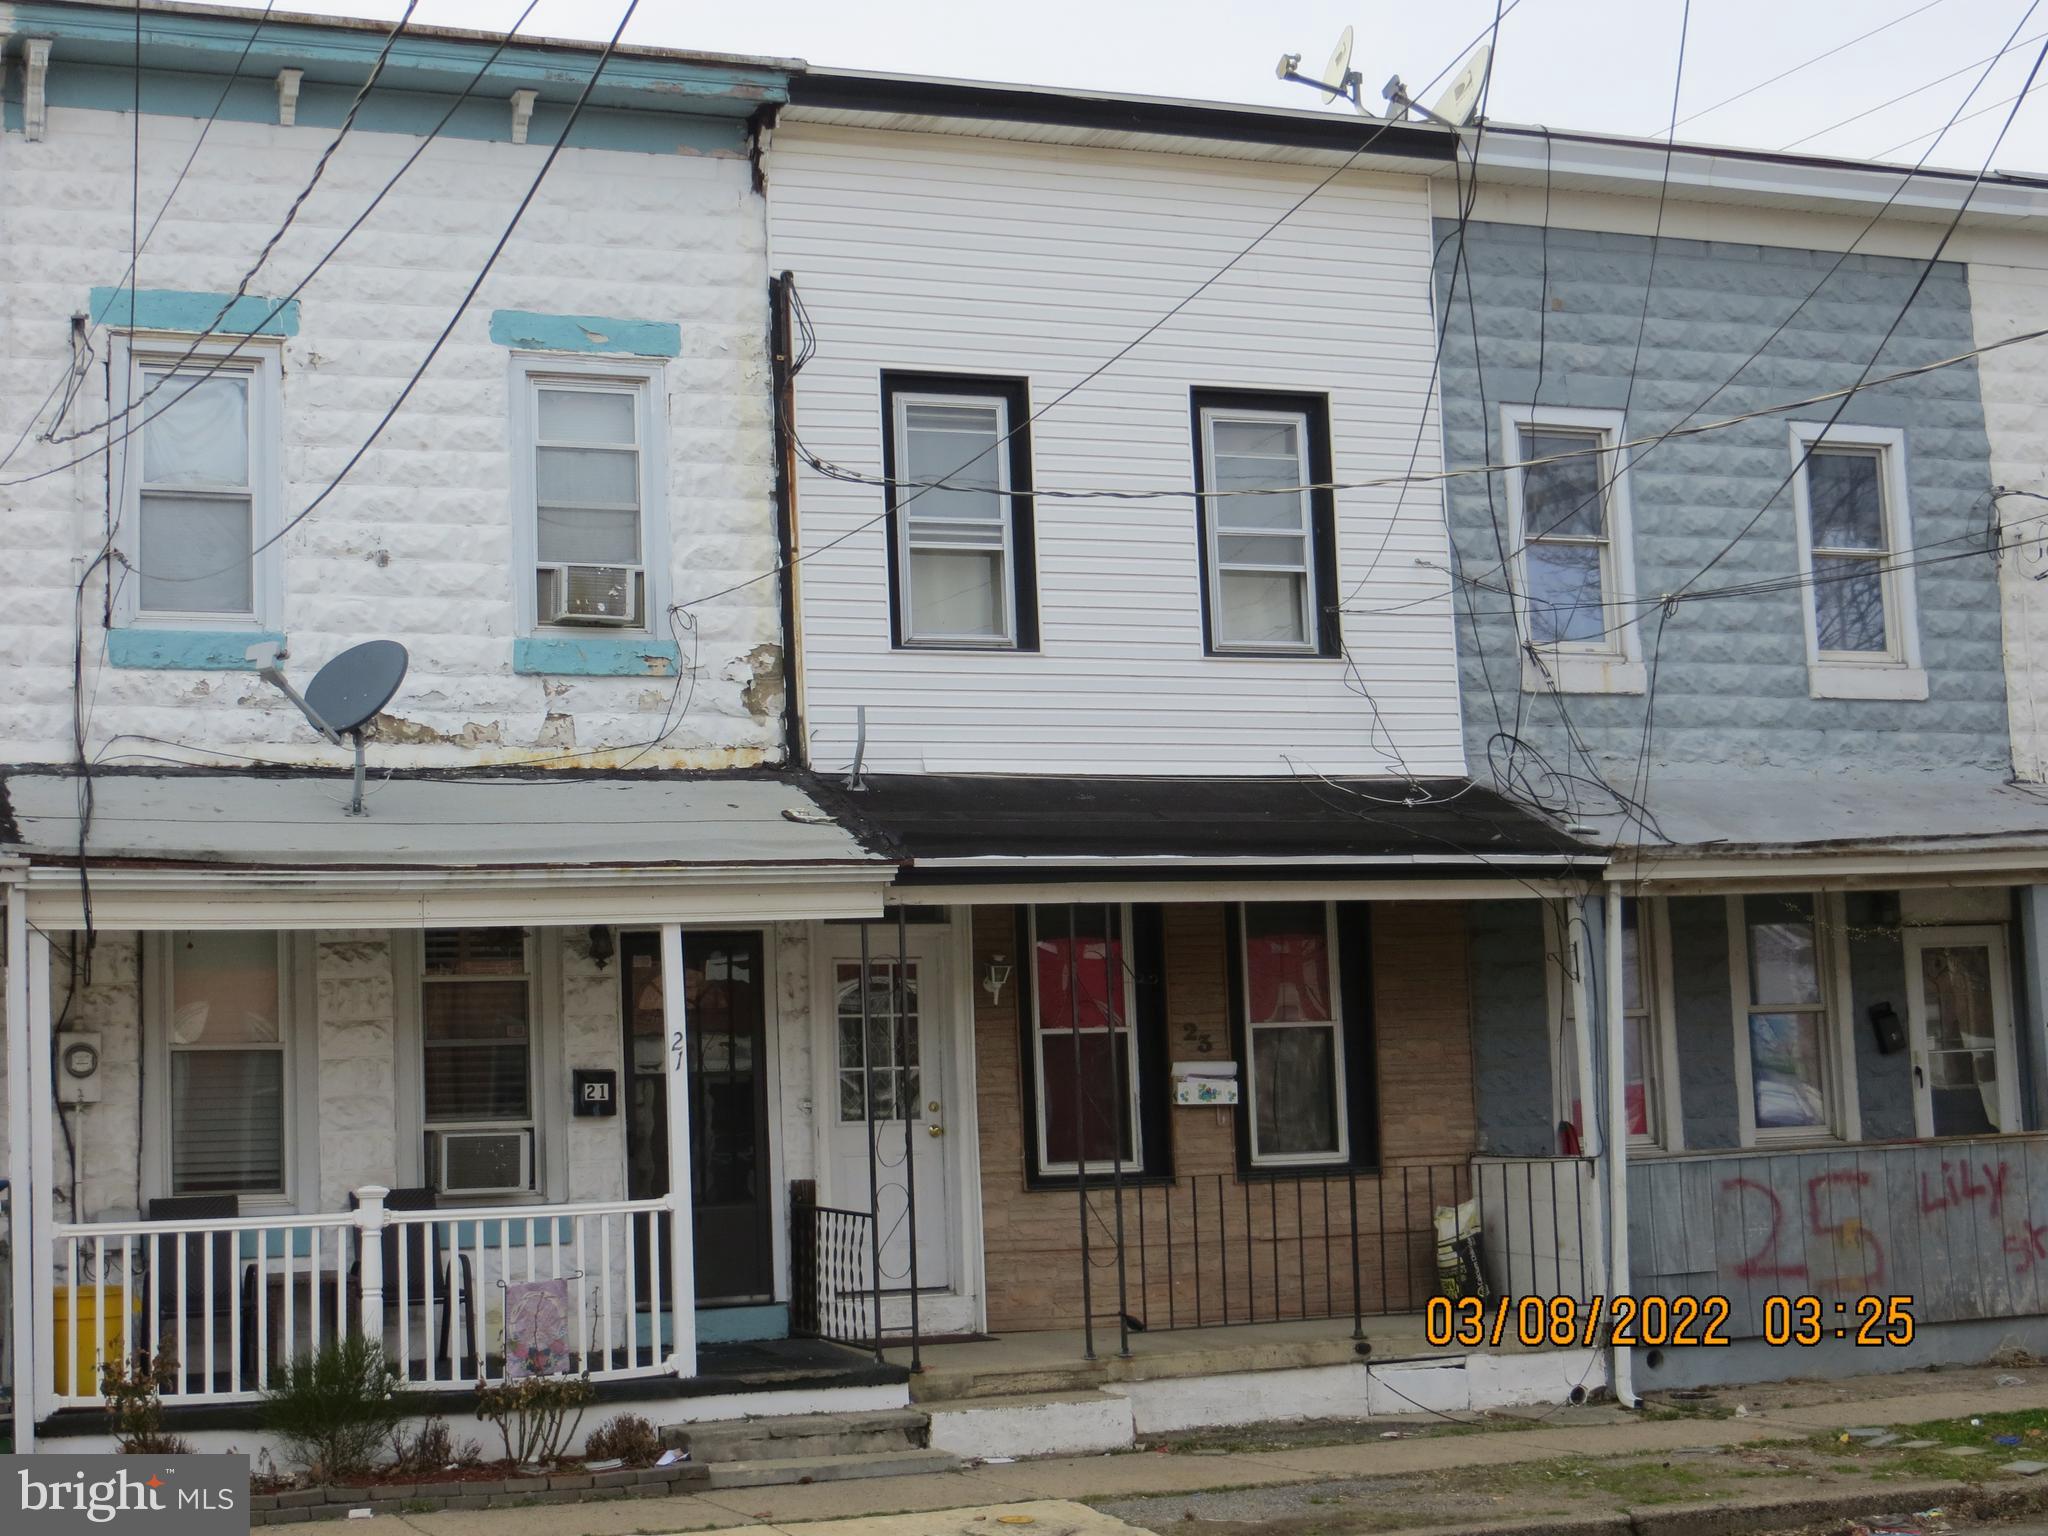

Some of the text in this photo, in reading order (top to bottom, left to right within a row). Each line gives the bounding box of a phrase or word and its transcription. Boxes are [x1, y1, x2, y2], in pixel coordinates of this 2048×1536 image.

[671, 1031, 684, 1071] 21
[1183, 1022, 1213, 1053] 23
[586, 1084, 606, 1099] 21
[1721, 1171, 1885, 1292] 25
